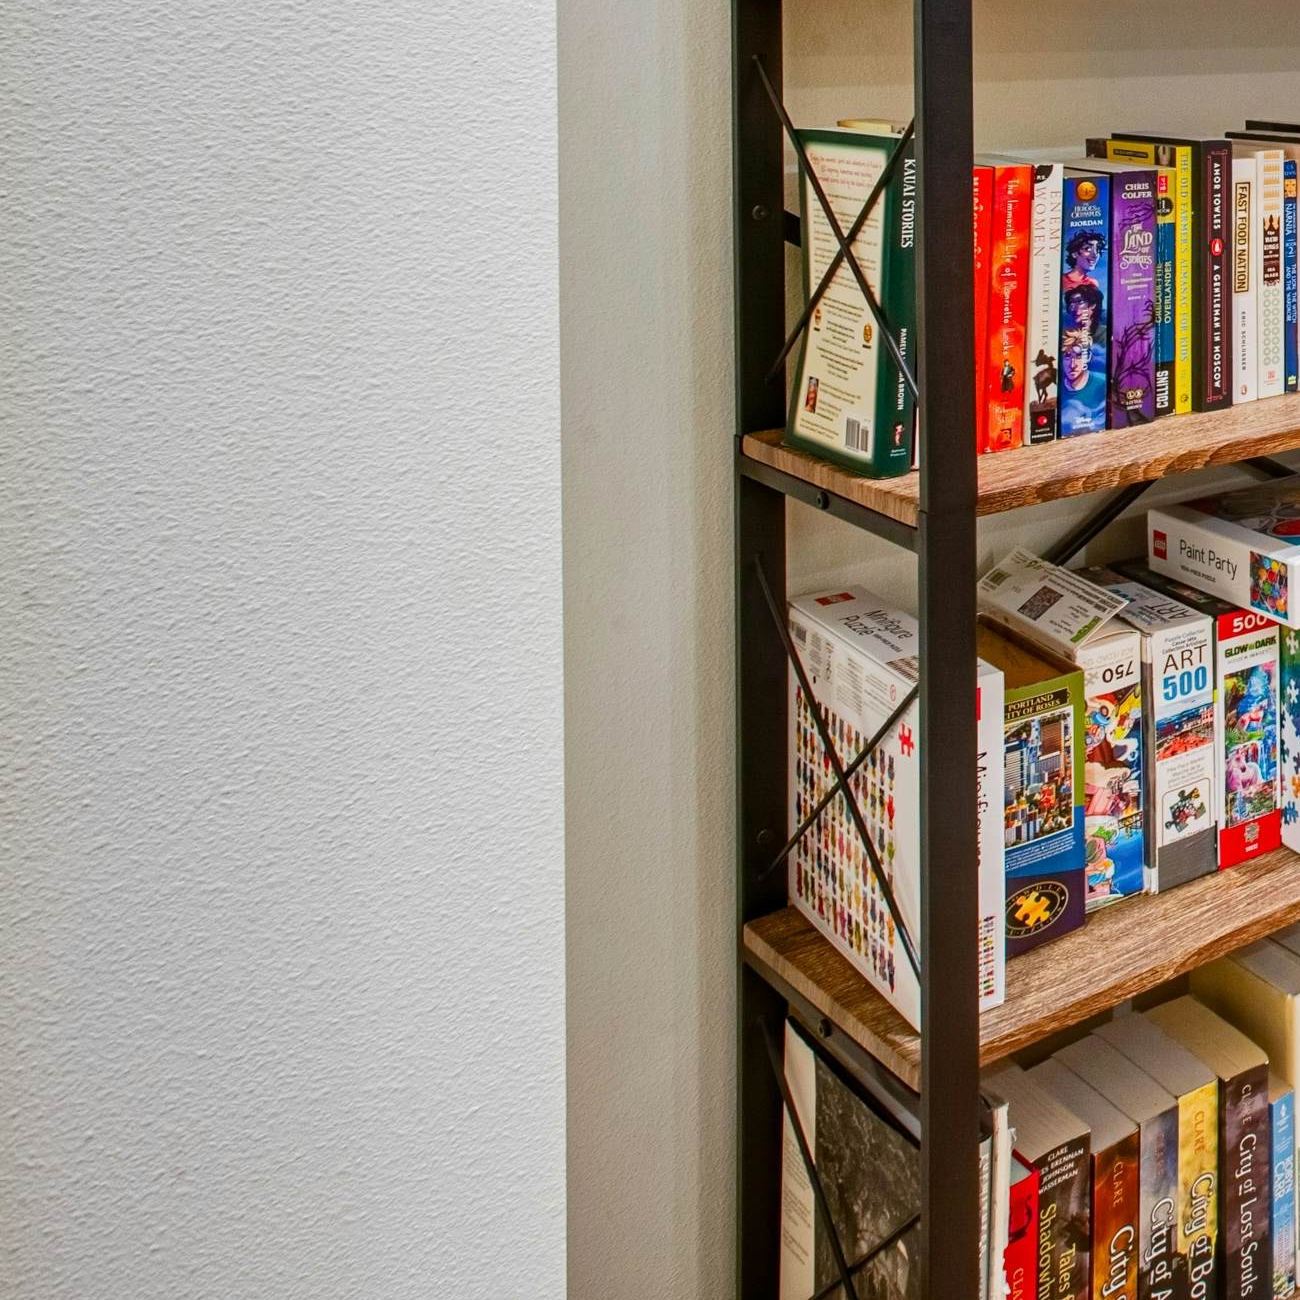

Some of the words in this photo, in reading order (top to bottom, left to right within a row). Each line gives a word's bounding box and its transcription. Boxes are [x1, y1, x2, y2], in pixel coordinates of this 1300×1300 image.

[902, 158, 916, 197] KAUAI
[1006, 178, 1020, 195] The
[1124, 182, 1149, 191] CHRIS
[1212, 162, 1221, 190] AMOR
[1121, 191, 1152, 199] COLFER
[1238, 186, 1248, 213] FAST
[900, 199, 914, 248] STORIES
[1005, 200, 1019, 239] Immortal
[1033, 186, 1048, 257] WOMEN
[1049, 189, 1062, 253] ENEMY
[1069, 219, 1103, 228] RIORDAN
[1212, 193, 1221, 230] TOWLES
[1285, 203, 1293, 236] NARNIA
[1120, 229, 1153, 255] LAND
[1238, 216, 1247, 245] FOOD
[1000, 267, 1016, 277] of
[1120, 254, 1153, 270] STORIES
[1237, 249, 1247, 290] NATION
[1164, 260, 1173, 324] OVERLANDER
[1212, 273, 1221, 329] GENTLEMAN
[1002, 327, 1015, 356] Lacks
[1212, 332, 1221, 341] IN
[1212, 345, 1221, 388] MOSCOW
[897, 383, 905, 410] BROWN
[1155, 370, 1169, 408] COLLINS
[1179, 539, 1206, 564] Paint
[1208, 549, 1238, 581] Party
[1232, 613, 1268, 633] 500
[1163, 645, 1208, 675] ART
[1225, 643, 1249, 658] GLOW
[1255, 635, 1277, 649] DARK
[1163, 665, 1208, 701] 500
[1004, 709, 1021, 720] ITY
[1022, 707, 1035, 717] OF
[1035, 699, 1061, 713] ROSES
[1008, 693, 1054, 711] PORTLAND
[1194, 1110, 1205, 1156] CLARE
[1047, 1146, 1069, 1161] CLARE
[1051, 1147, 1084, 1169] BRENNAN
[1235, 1133, 1257, 1179] City
[1041, 1161, 1075, 1185] JOHNSON
[1112, 1161, 1124, 1208] CLARE
[1238, 1179, 1257, 1197] of
[1184, 1172, 1215, 1235] City
[1239, 1197, 1258, 1240] Lost
[1144, 1198, 1174, 1263] City
[1102, 1225, 1135, 1297] City
[1189, 1235, 1212, 1258] of
[1058, 1242, 1076, 1293] Tales
[1150, 1261, 1172, 1286] of
[1239, 1242, 1259, 1298] Souls
